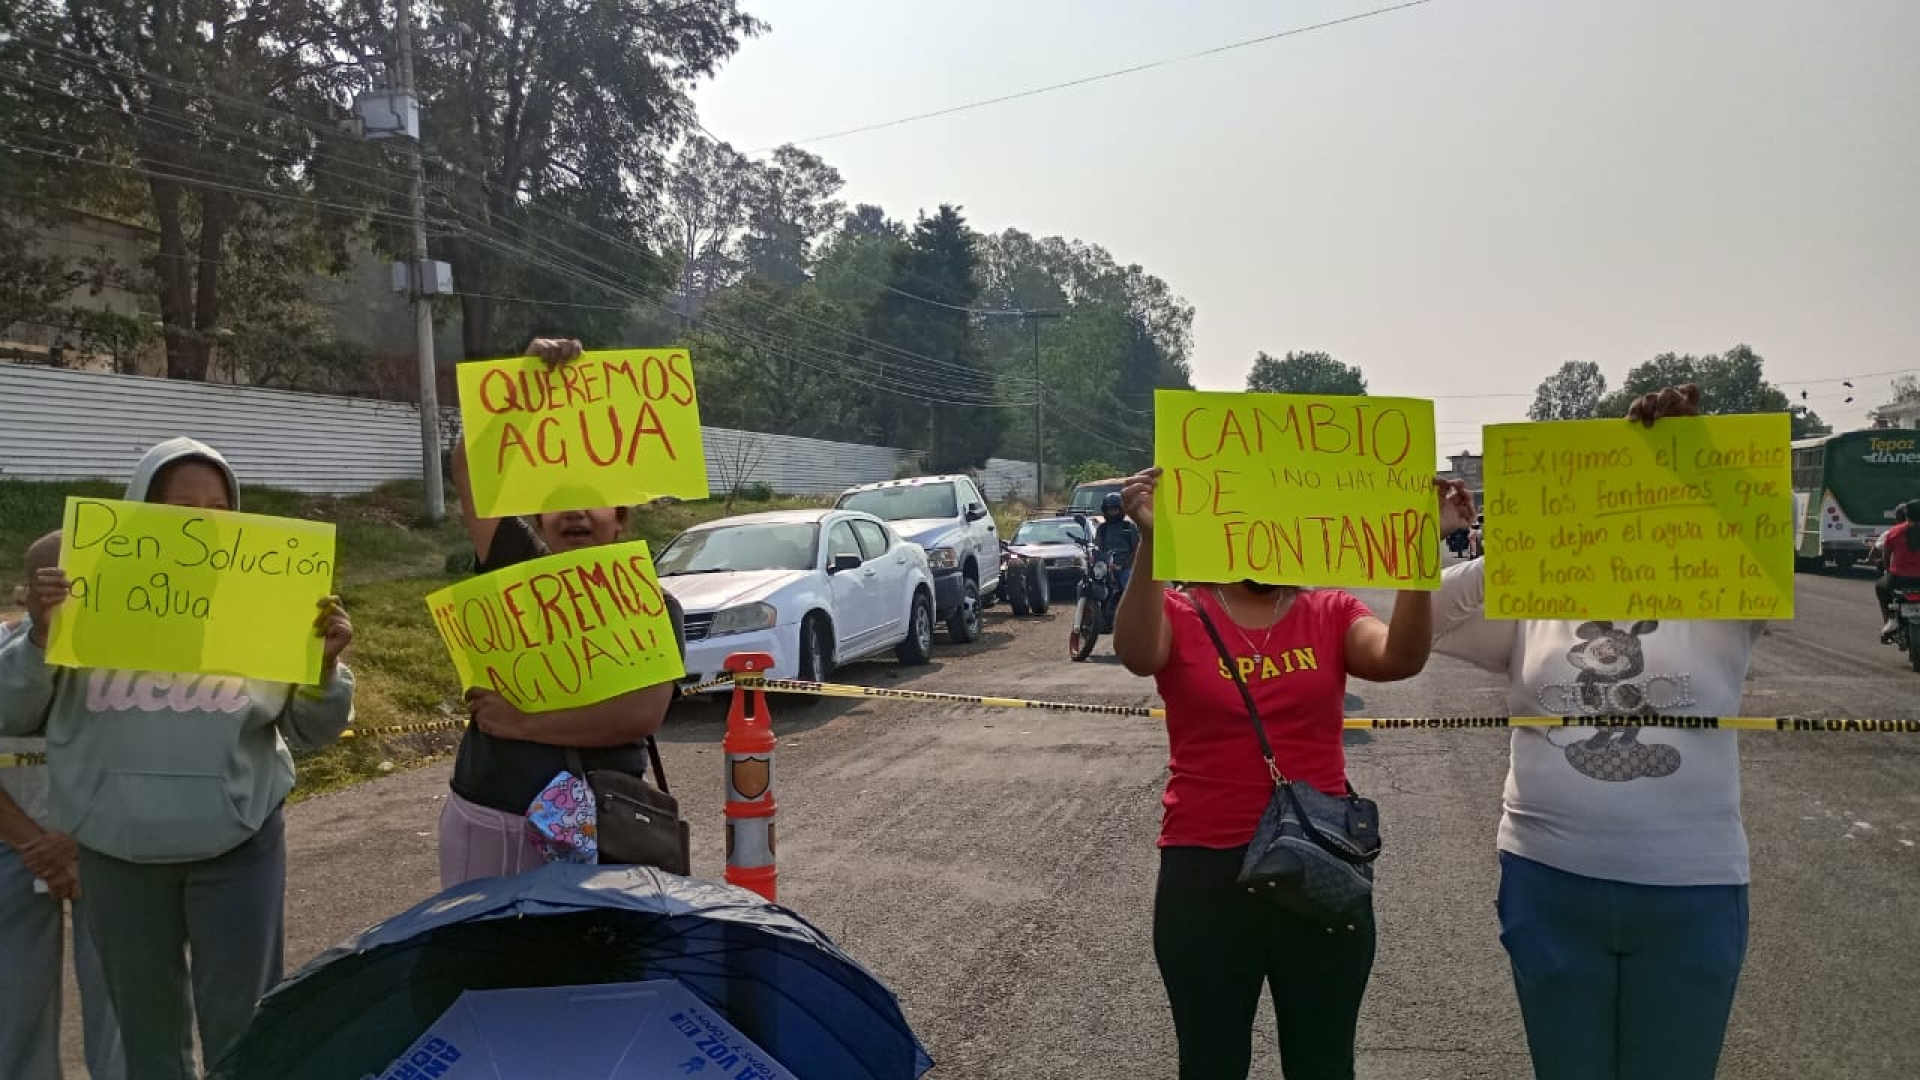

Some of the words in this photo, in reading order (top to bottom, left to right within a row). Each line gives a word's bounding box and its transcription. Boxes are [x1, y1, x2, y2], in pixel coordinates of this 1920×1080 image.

[480, 354, 694, 415] QUEREMOS
[498, 401, 677, 474] AGUA
[1182, 403, 1411, 465] CAMBIO
[1502, 437, 1633, 486] Exigimos
[1655, 435, 1678, 472] el
[1174, 467, 1248, 516] DE
[1490, 489, 1519, 517] de
[1541, 484, 1577, 517] los
[1734, 478, 1780, 507] que
[72, 501, 160, 558] Den
[175, 518, 331, 577] Solución
[1223, 509, 1439, 580] FONTANERO
[1549, 522, 1609, 556] dejan
[1622, 522, 1643, 543] el
[1652, 520, 1703, 549] agua
[1717, 520, 1744, 540] un
[69, 573, 102, 613] al
[1490, 562, 1516, 587] de
[1539, 558, 1596, 585] horas
[1668, 554, 1720, 580] toda
[1740, 555, 1762, 578] la
[1739, 590, 1781, 618] hay
[487, 627, 666, 705] AGUA!!!
[1217, 647, 1318, 684] SPAIN
